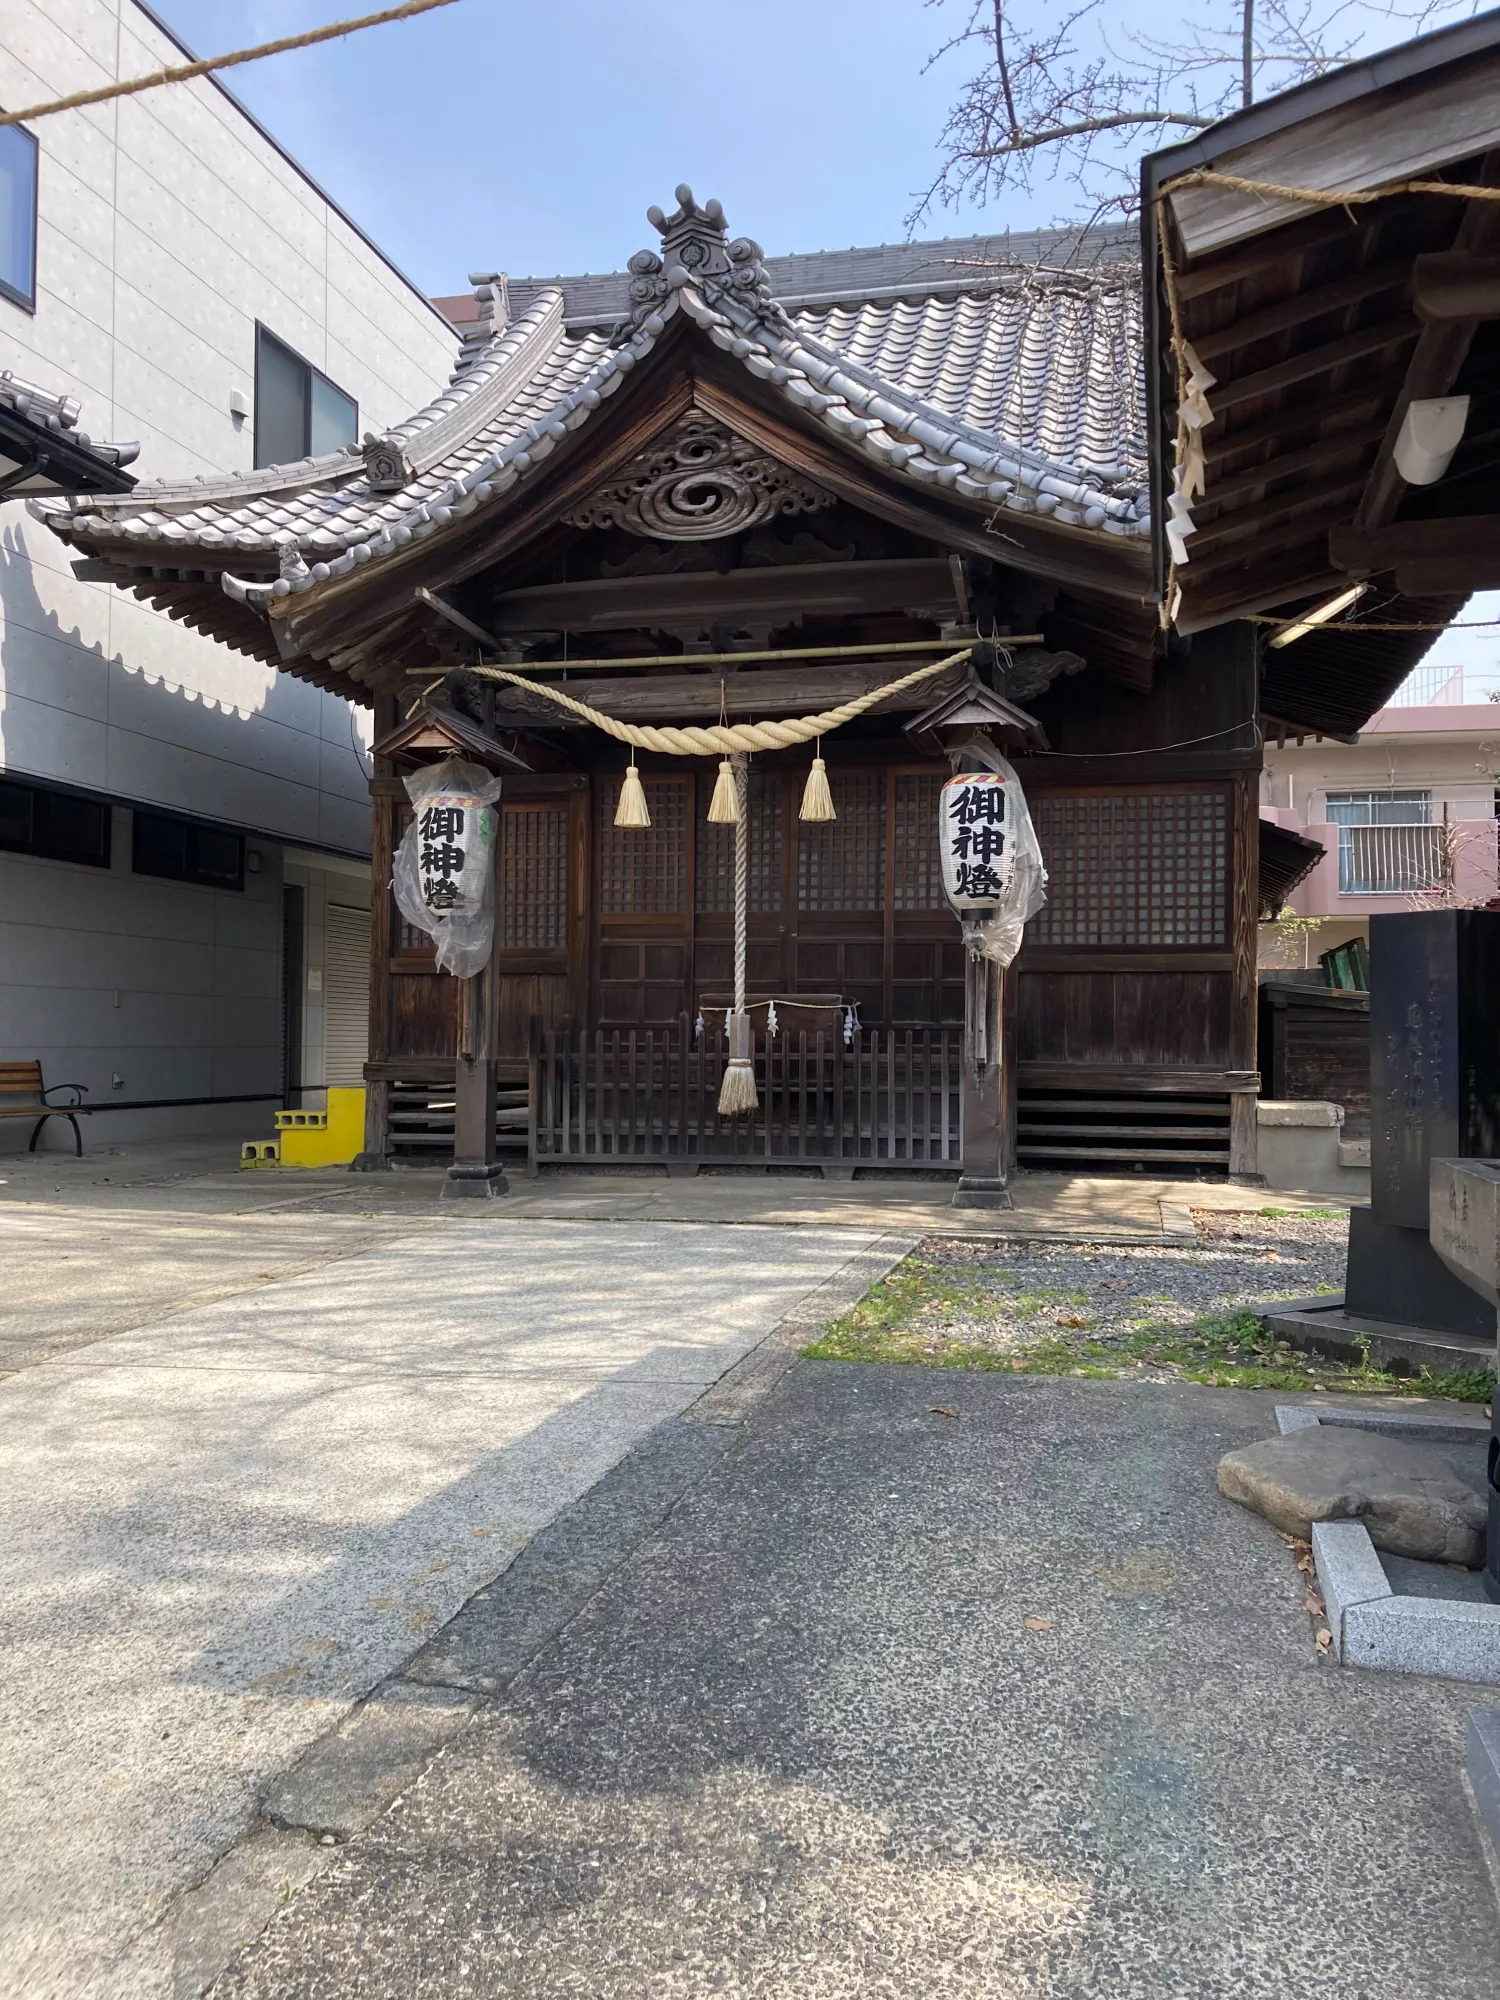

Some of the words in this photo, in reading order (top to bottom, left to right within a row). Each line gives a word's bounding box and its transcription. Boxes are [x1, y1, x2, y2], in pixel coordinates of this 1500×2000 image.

[419, 807, 465, 909] 御神燈
[949, 786, 1005, 899] 御神燈
